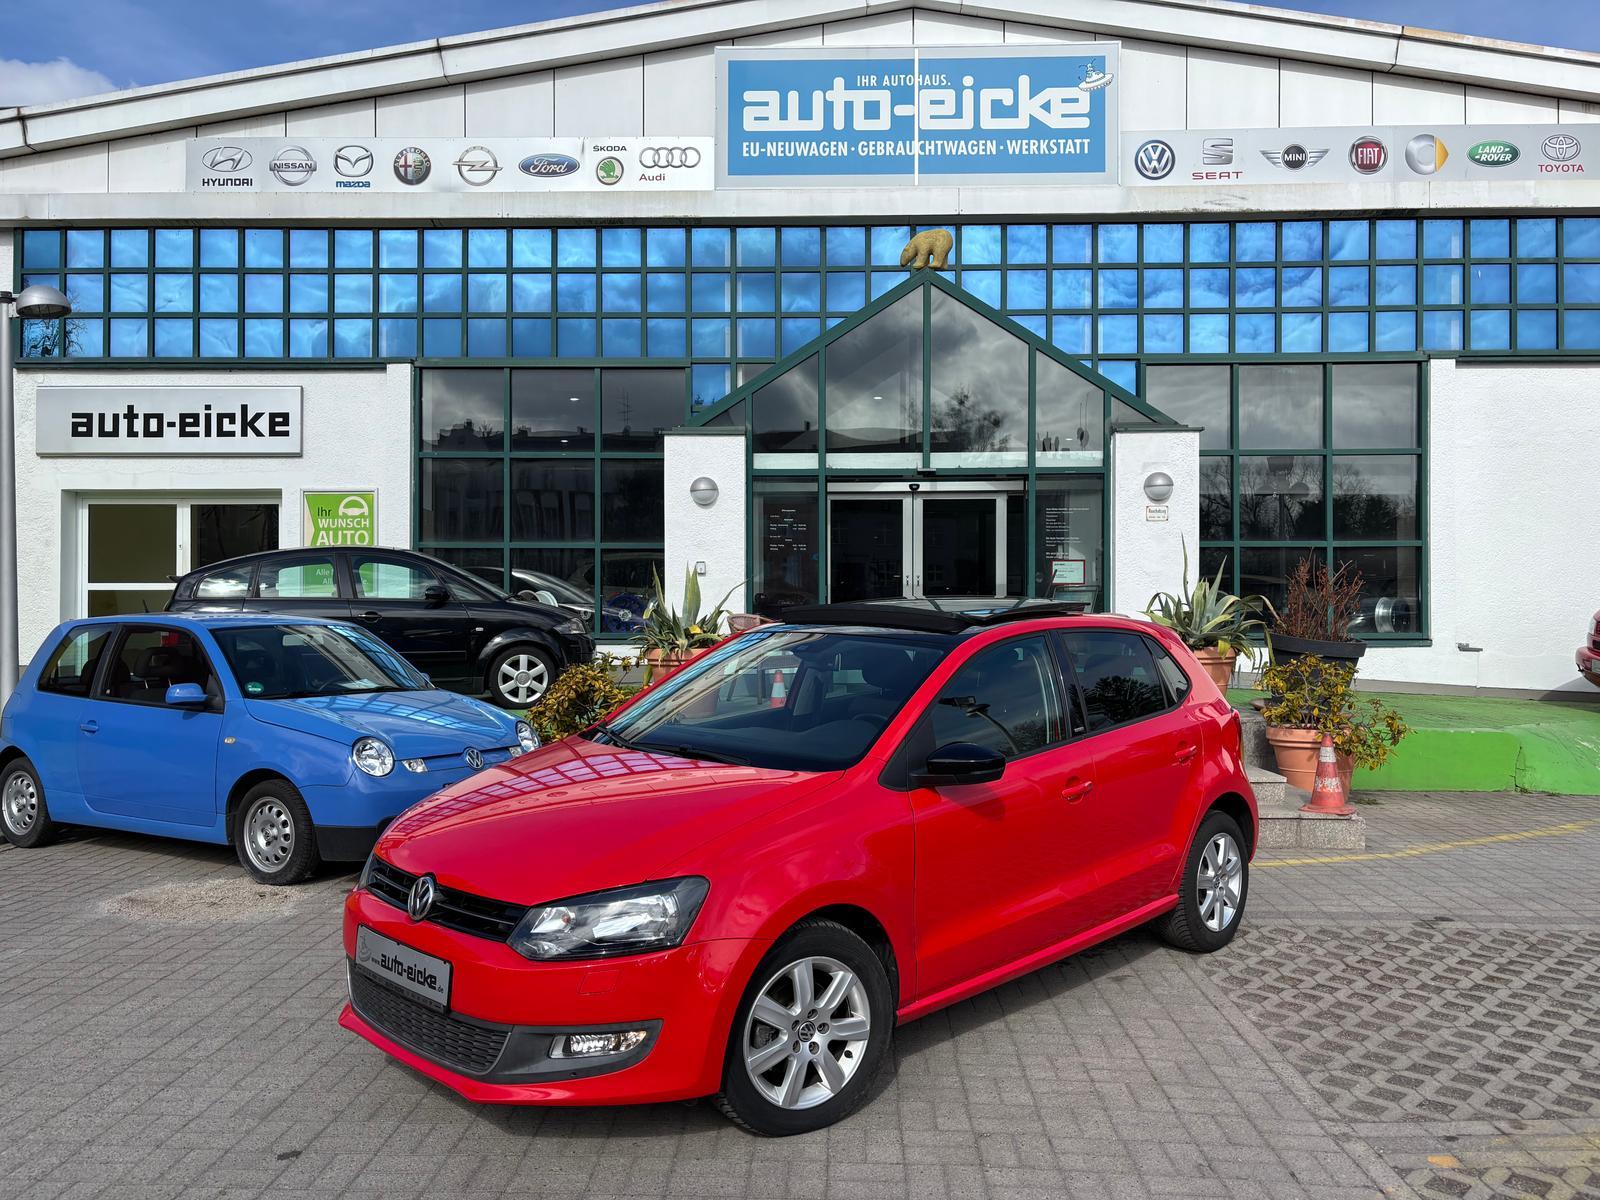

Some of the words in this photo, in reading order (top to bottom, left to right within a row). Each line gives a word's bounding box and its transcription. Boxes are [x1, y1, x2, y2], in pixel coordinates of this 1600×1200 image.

[857, 75, 877, 87] IHR
[742, 74, 1091, 132] auto-eicke
[742, 141, 848, 158] EU-NEUWAGEN
[858, 139, 997, 157] GEBRAUCHTWAGEN
[1006, 138, 1091, 156] WERKSTATT
[1284, 153, 1306, 161] MINI
[1357, 146, 1380, 165] FIAT
[273, 162, 313, 170] NISSAN
[530, 156, 569, 173] Ford
[1538, 164, 1585, 173] TOYOTA
[639, 173, 666, 182] Audi
[1192, 171, 1244, 180] SEAT
[202, 178, 253, 187] HYUNDAI
[335, 180, 371, 188] mazda
[71, 404, 290, 438] auto-eicke
[317, 506, 332, 517] Ihr
[318, 518, 369, 529] WUNSCH
[316, 530, 369, 546] AUTO
